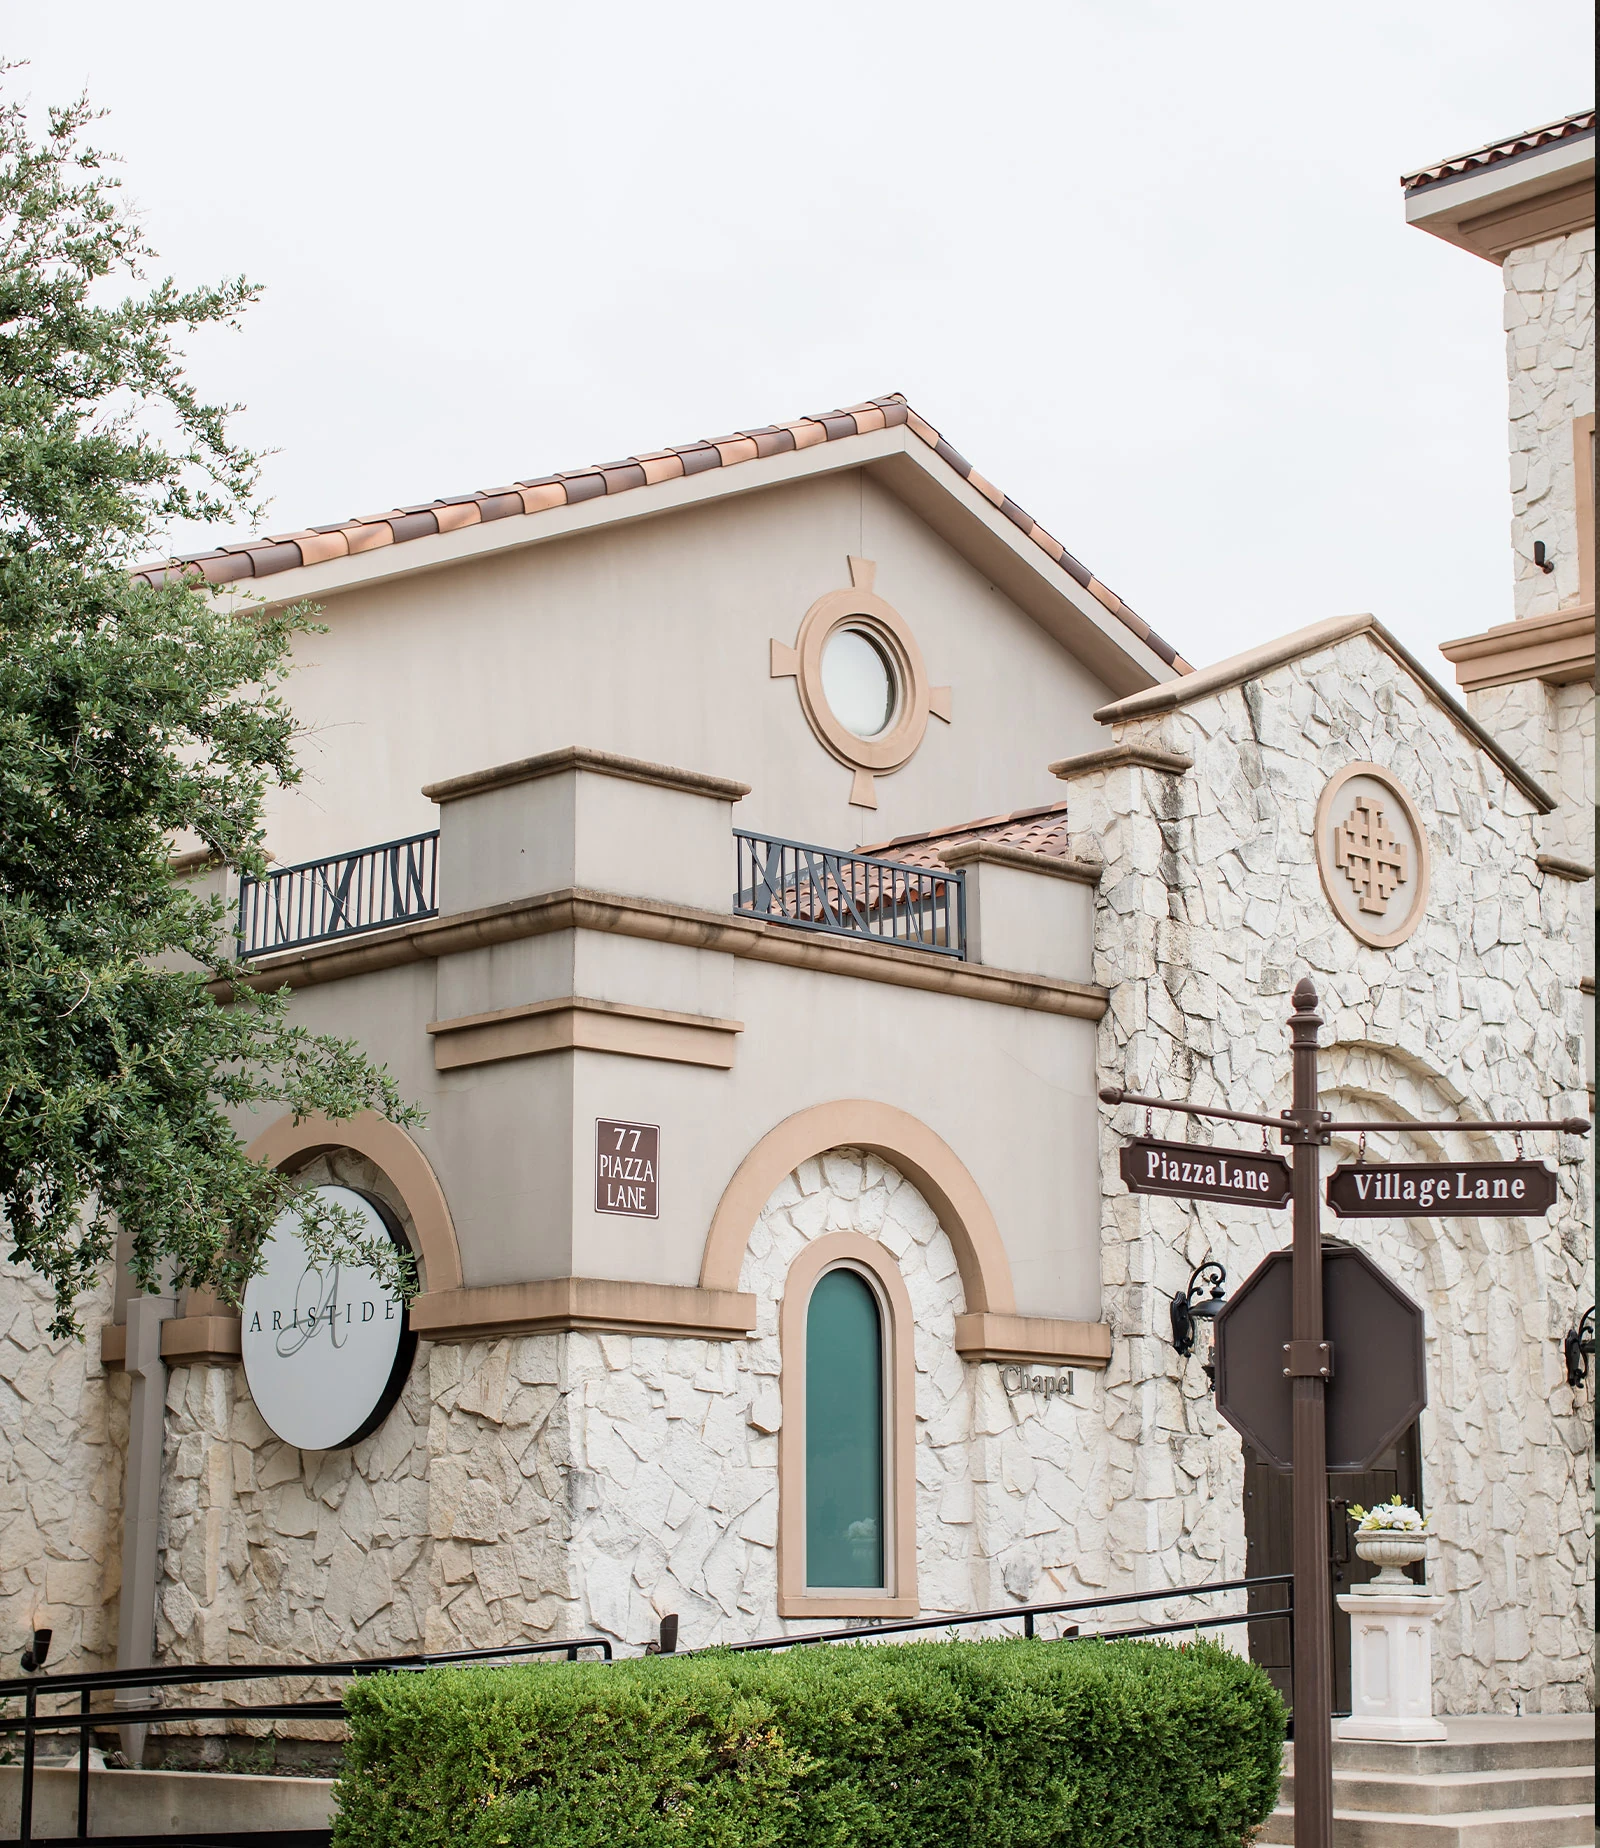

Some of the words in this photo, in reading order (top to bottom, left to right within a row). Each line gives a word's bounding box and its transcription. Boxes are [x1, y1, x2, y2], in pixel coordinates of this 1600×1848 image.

[613, 1127, 642, 1152] 77
[600, 1154, 655, 1183] PIAZZA
[1146, 1151, 1216, 1186] Piazza
[1219, 1159, 1271, 1192] Lane
[607, 1183, 647, 1210] LANE
[1354, 1172, 1451, 1207] Village
[1455, 1172, 1527, 1200] Lane
[250, 1298, 395, 1333] ARISTIDE
[1001, 1366, 1074, 1402] Chapel
